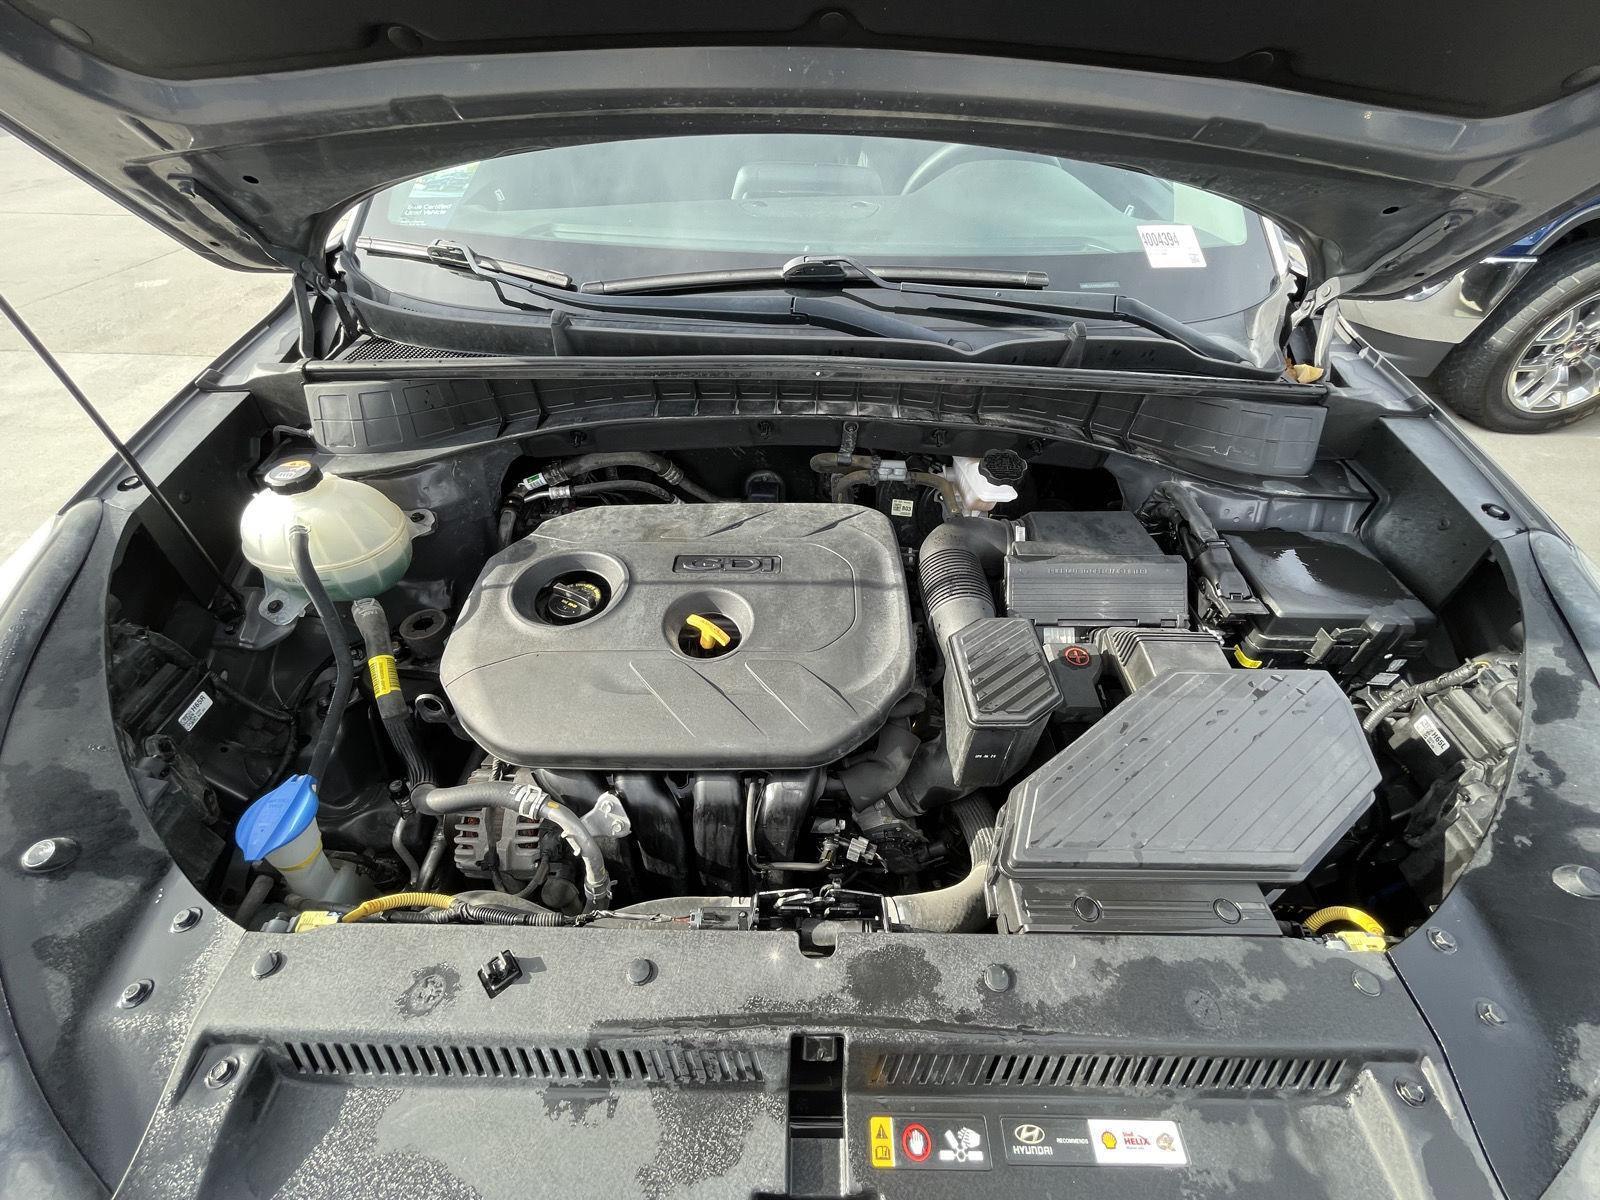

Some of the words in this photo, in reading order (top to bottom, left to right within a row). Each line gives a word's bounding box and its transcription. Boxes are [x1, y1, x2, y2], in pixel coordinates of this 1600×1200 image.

[682, 556, 775, 573] GDI
[1431, 731, 1446, 750] H65L
[1124, 1137, 1151, 1146] HELIX
[1012, 1145, 1053, 1156] HYUNDAI
